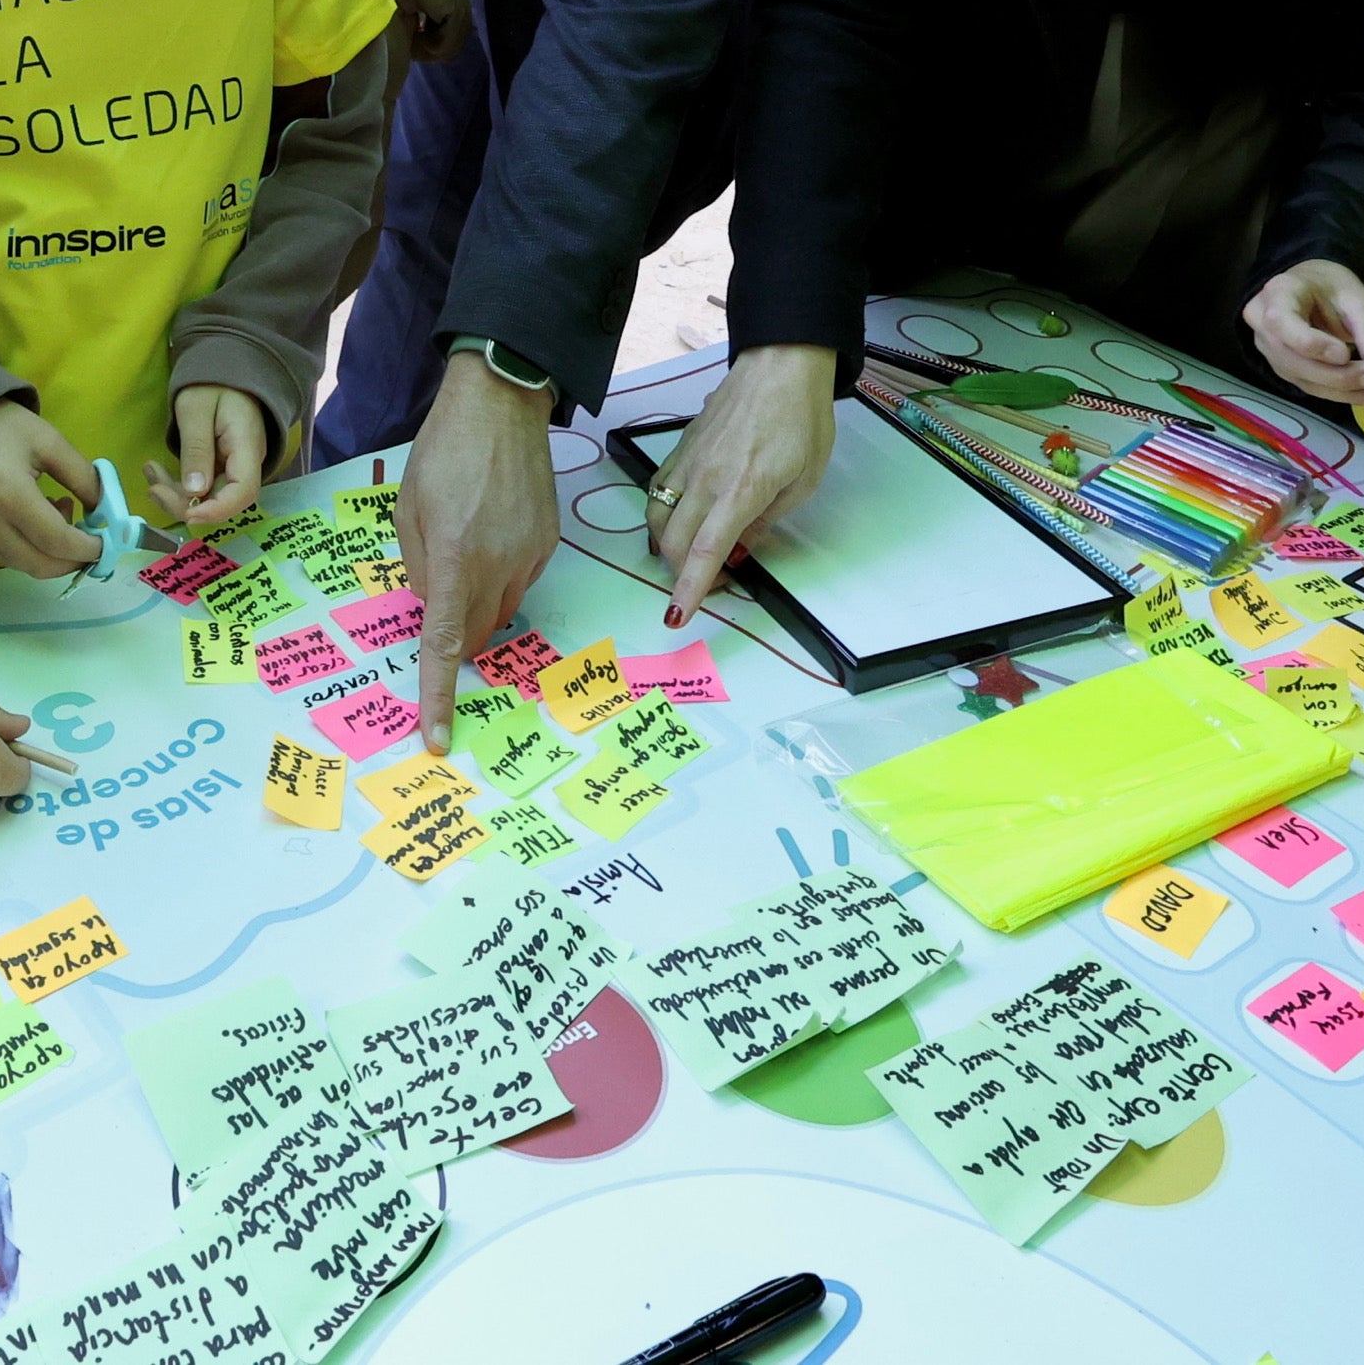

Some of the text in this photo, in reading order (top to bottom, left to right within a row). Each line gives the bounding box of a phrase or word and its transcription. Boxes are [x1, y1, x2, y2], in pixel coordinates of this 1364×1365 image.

[7, 225, 167, 258] innspire
[255, 629, 323, 658] de apoyo
[261, 642, 336, 676] fundación
[295, 656, 347, 679] crear
[562, 659, 618, 701] Regalos
[303, 668, 380, 709] centros
[1303, 700, 1338, 712] con
[31, 691, 115, 754] 3
[285, 745, 313, 797] Amigos
[489, 731, 541, 781] amigable
[544, 745, 574, 764] Ser
[314, 758, 342, 799] Hacer
[583, 763, 629, 804] amigos
[619, 783, 668, 812] Hacer
[55, 768, 243, 852] Islas de
[1253, 815, 1321, 852] Shen
[560, 852, 664, 905] Amista
[514, 889, 546, 917] sus
[1138, 879, 1196, 935] DAVID
[81, 914, 106, 937] la
[52, 934, 118, 981] Apoyo
[588, 946, 617, 968] Un
[829, 947, 947, 997] Un persona
[480, 1036, 517, 1065] sus
[210, 1039, 328, 1110] actividades
[1158, 1053, 1233, 1102] Gente
[226, 1103, 268, 1136] las
[1082, 1133, 1125, 1158] Un
[962, 1162, 984, 1177] a
[272, 1159, 386, 1253] medicina
[62, 1235, 233, 1344] con un mando
[224, 1274, 248, 1297] a
[67, 1287, 216, 1364] distancia
[202, 1305, 272, 1358] para
